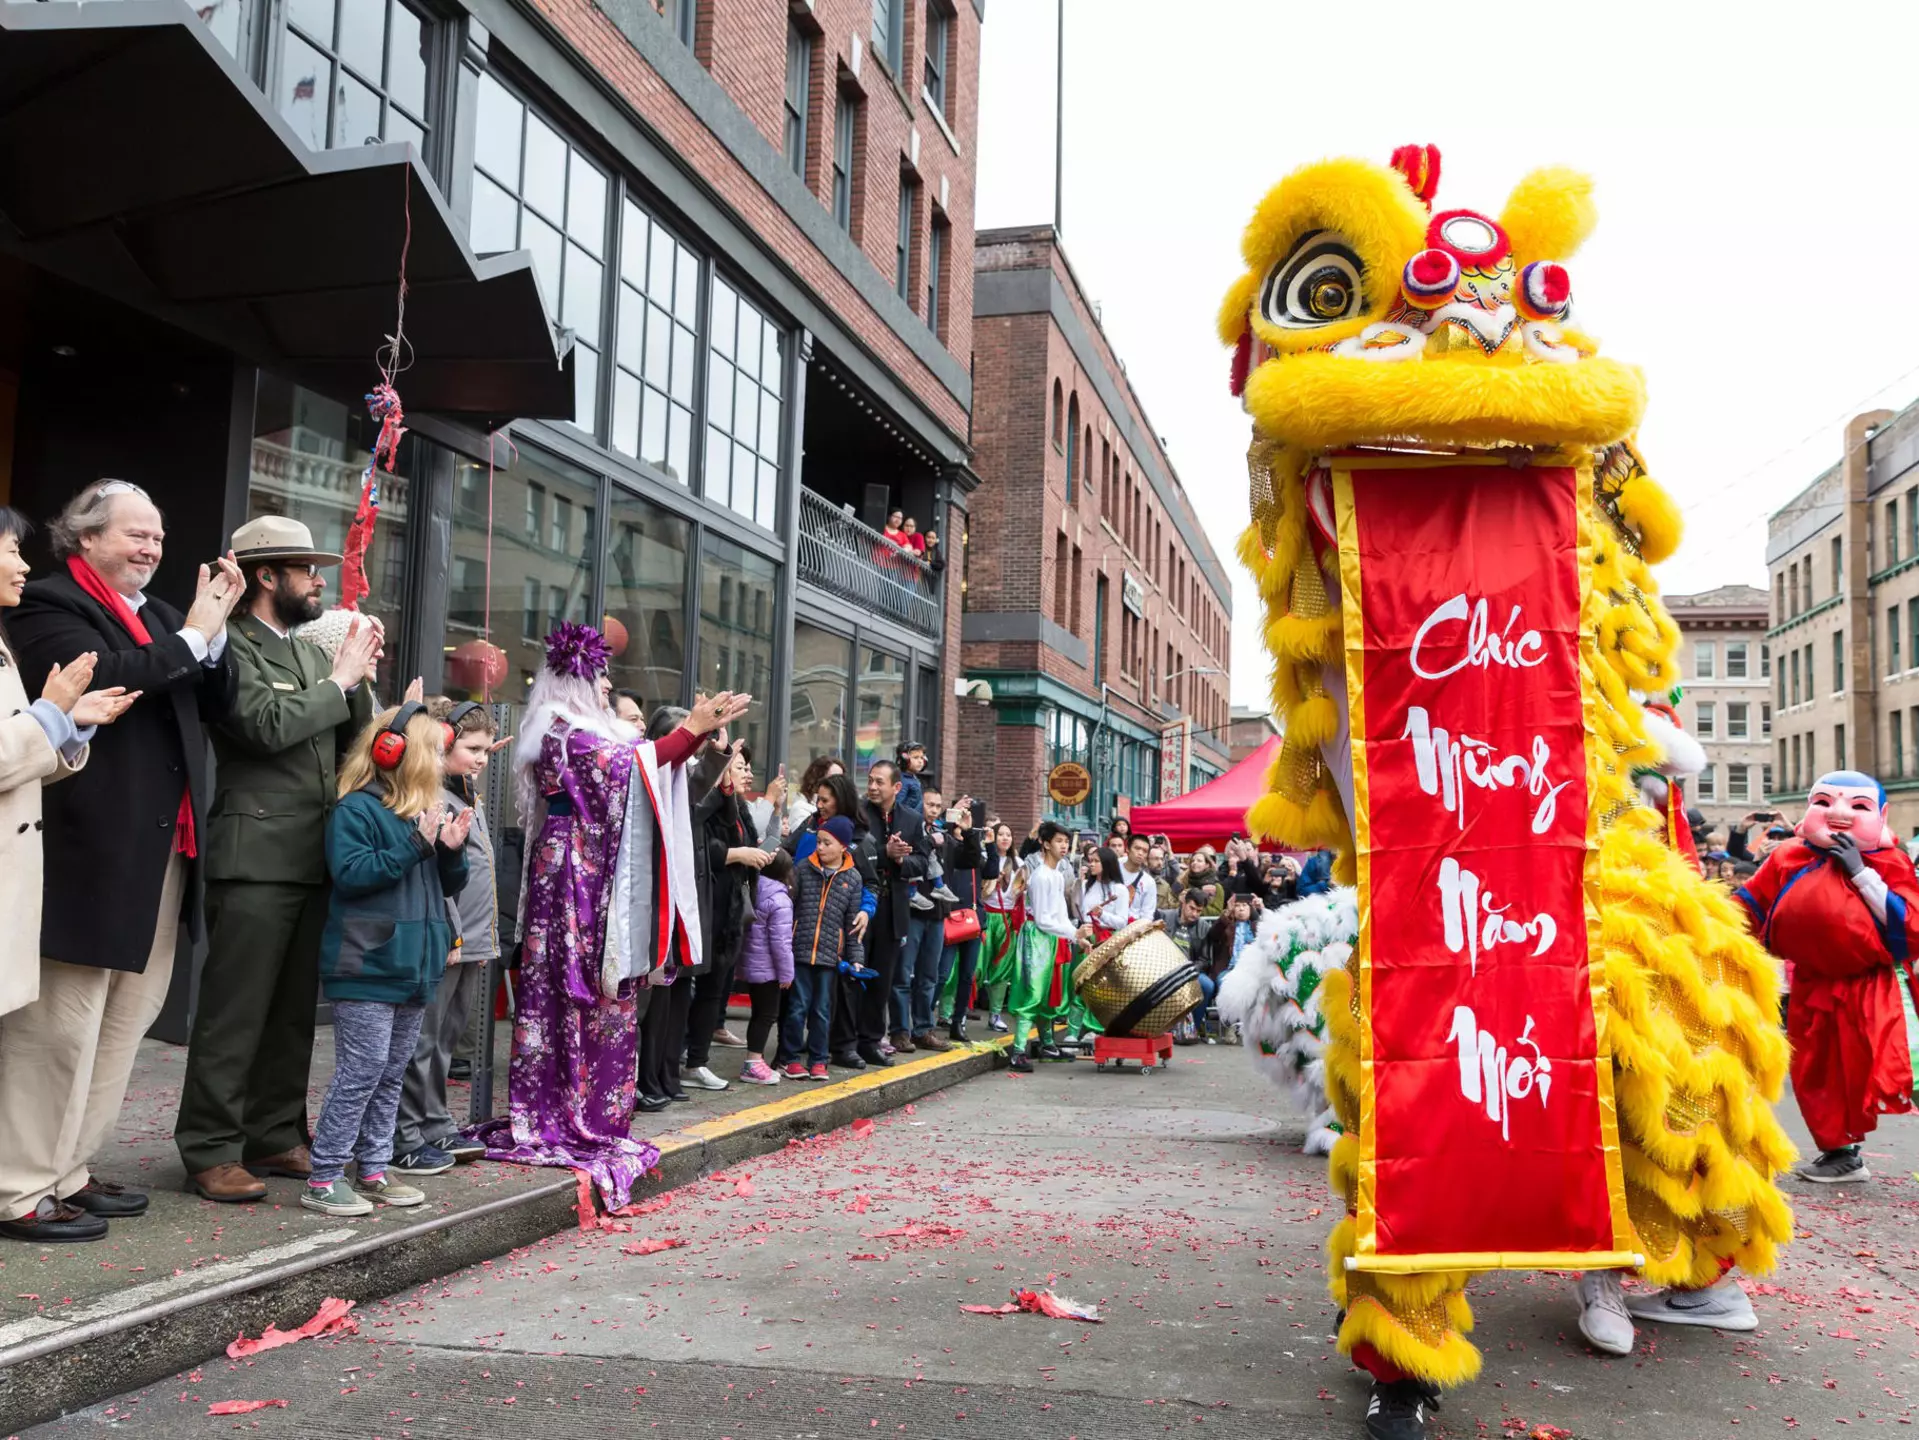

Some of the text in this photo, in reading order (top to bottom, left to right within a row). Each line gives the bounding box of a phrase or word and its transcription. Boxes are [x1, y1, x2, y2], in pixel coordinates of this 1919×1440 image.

[1410, 593, 1548, 679] Chúc
[1437, 857, 1557, 978] Năm
[1445, 1005, 1552, 1141] Mới
